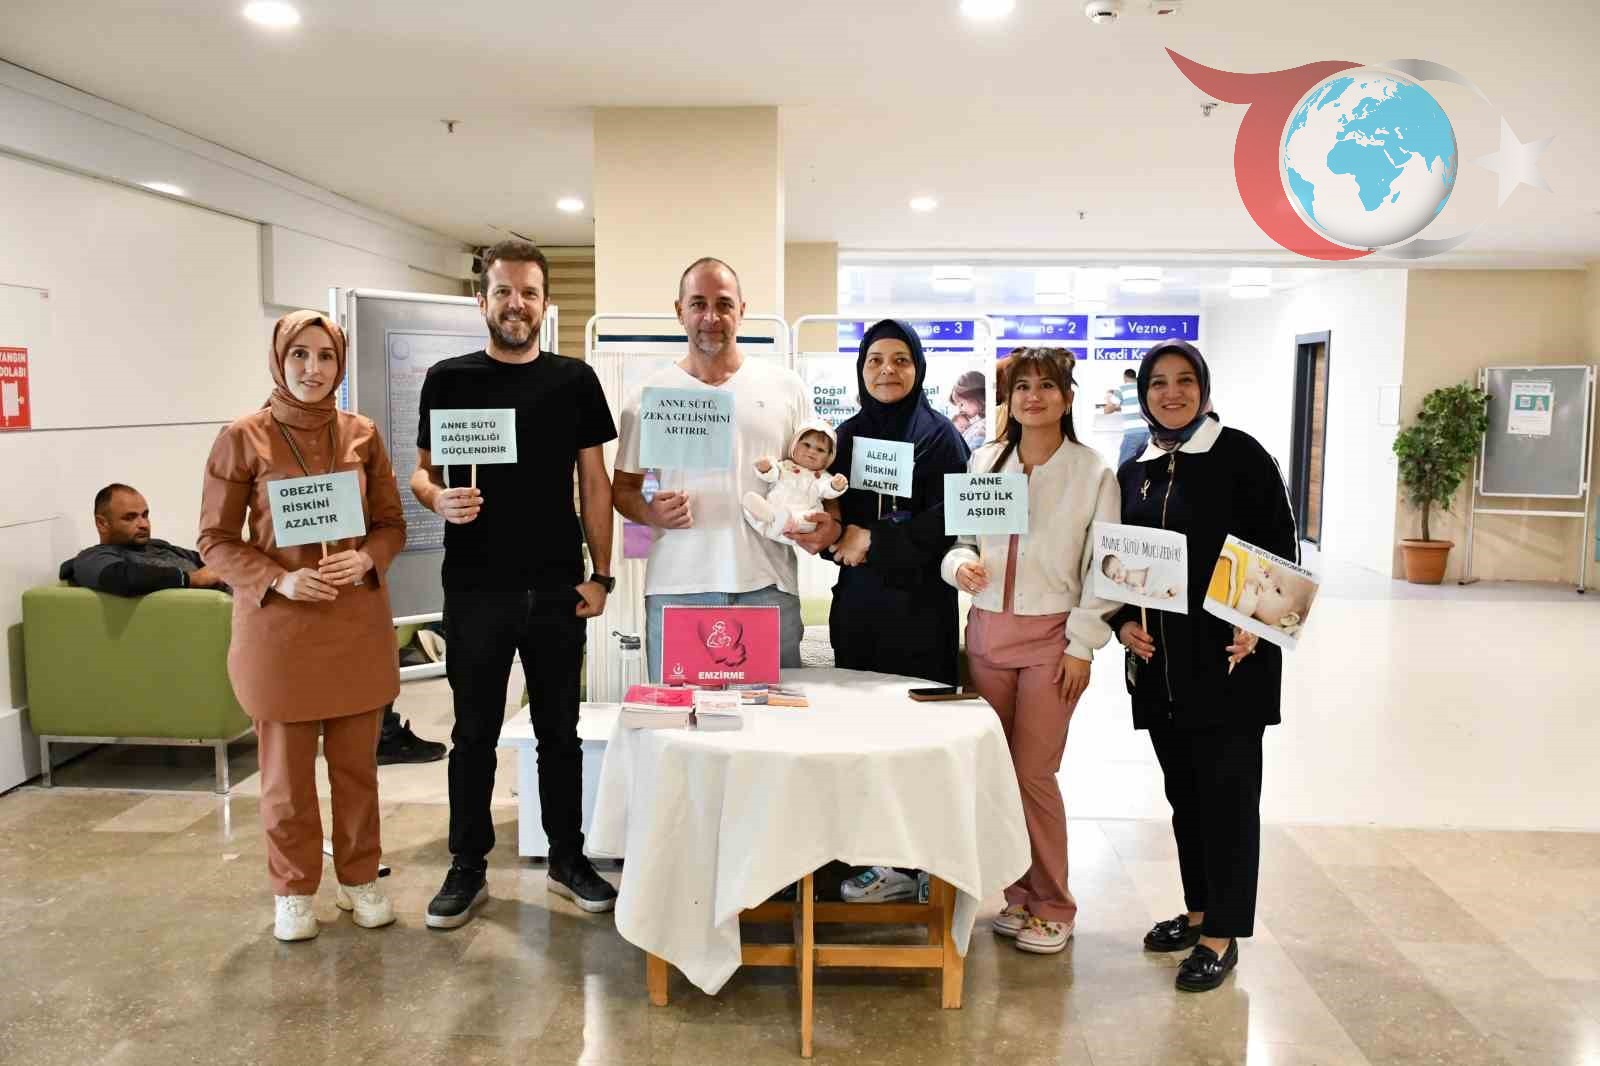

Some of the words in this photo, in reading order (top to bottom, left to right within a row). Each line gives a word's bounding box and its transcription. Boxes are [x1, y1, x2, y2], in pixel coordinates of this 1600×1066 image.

[955, 321, 963, 334] 3
[1068, 321, 1076, 334] 2
[1127, 321, 1167, 334] Vezne
[1182, 321, 1188, 334] 1
[1096, 348, 1128, 360] Kredi
[659, 399, 686, 408] ANNE
[813, 396, 840, 405] Olan
[643, 411, 671, 421] ZEKA
[673, 412, 731, 423] GELİŞİMİNİ
[441, 421, 468, 429] ANNE
[471, 420, 496, 429] SÜTÜ
[664, 426, 709, 435] ARTIRIR.
[441, 433, 500, 443] BAĞIŞIKLIĞI
[441, 445, 507, 456] GÜÇLENDİRİR
[866, 450, 897, 462] ALERJİ
[865, 464, 897, 477] RİSKİNİ
[862, 479, 899, 491] AZALTIR
[969, 476, 1003, 486] ANNE
[279, 482, 334, 497] OBEZİTE
[959, 490, 991, 501] SÜTÜ
[994, 489, 1014, 501] İLK
[282, 497, 330, 513] RİSKİNİ
[967, 507, 1006, 517] AŞIDIR
[285, 514, 338, 529] AZALTIR
[1101, 535, 1120, 552] ANNE
[697, 669, 744, 680] EMZİRME
